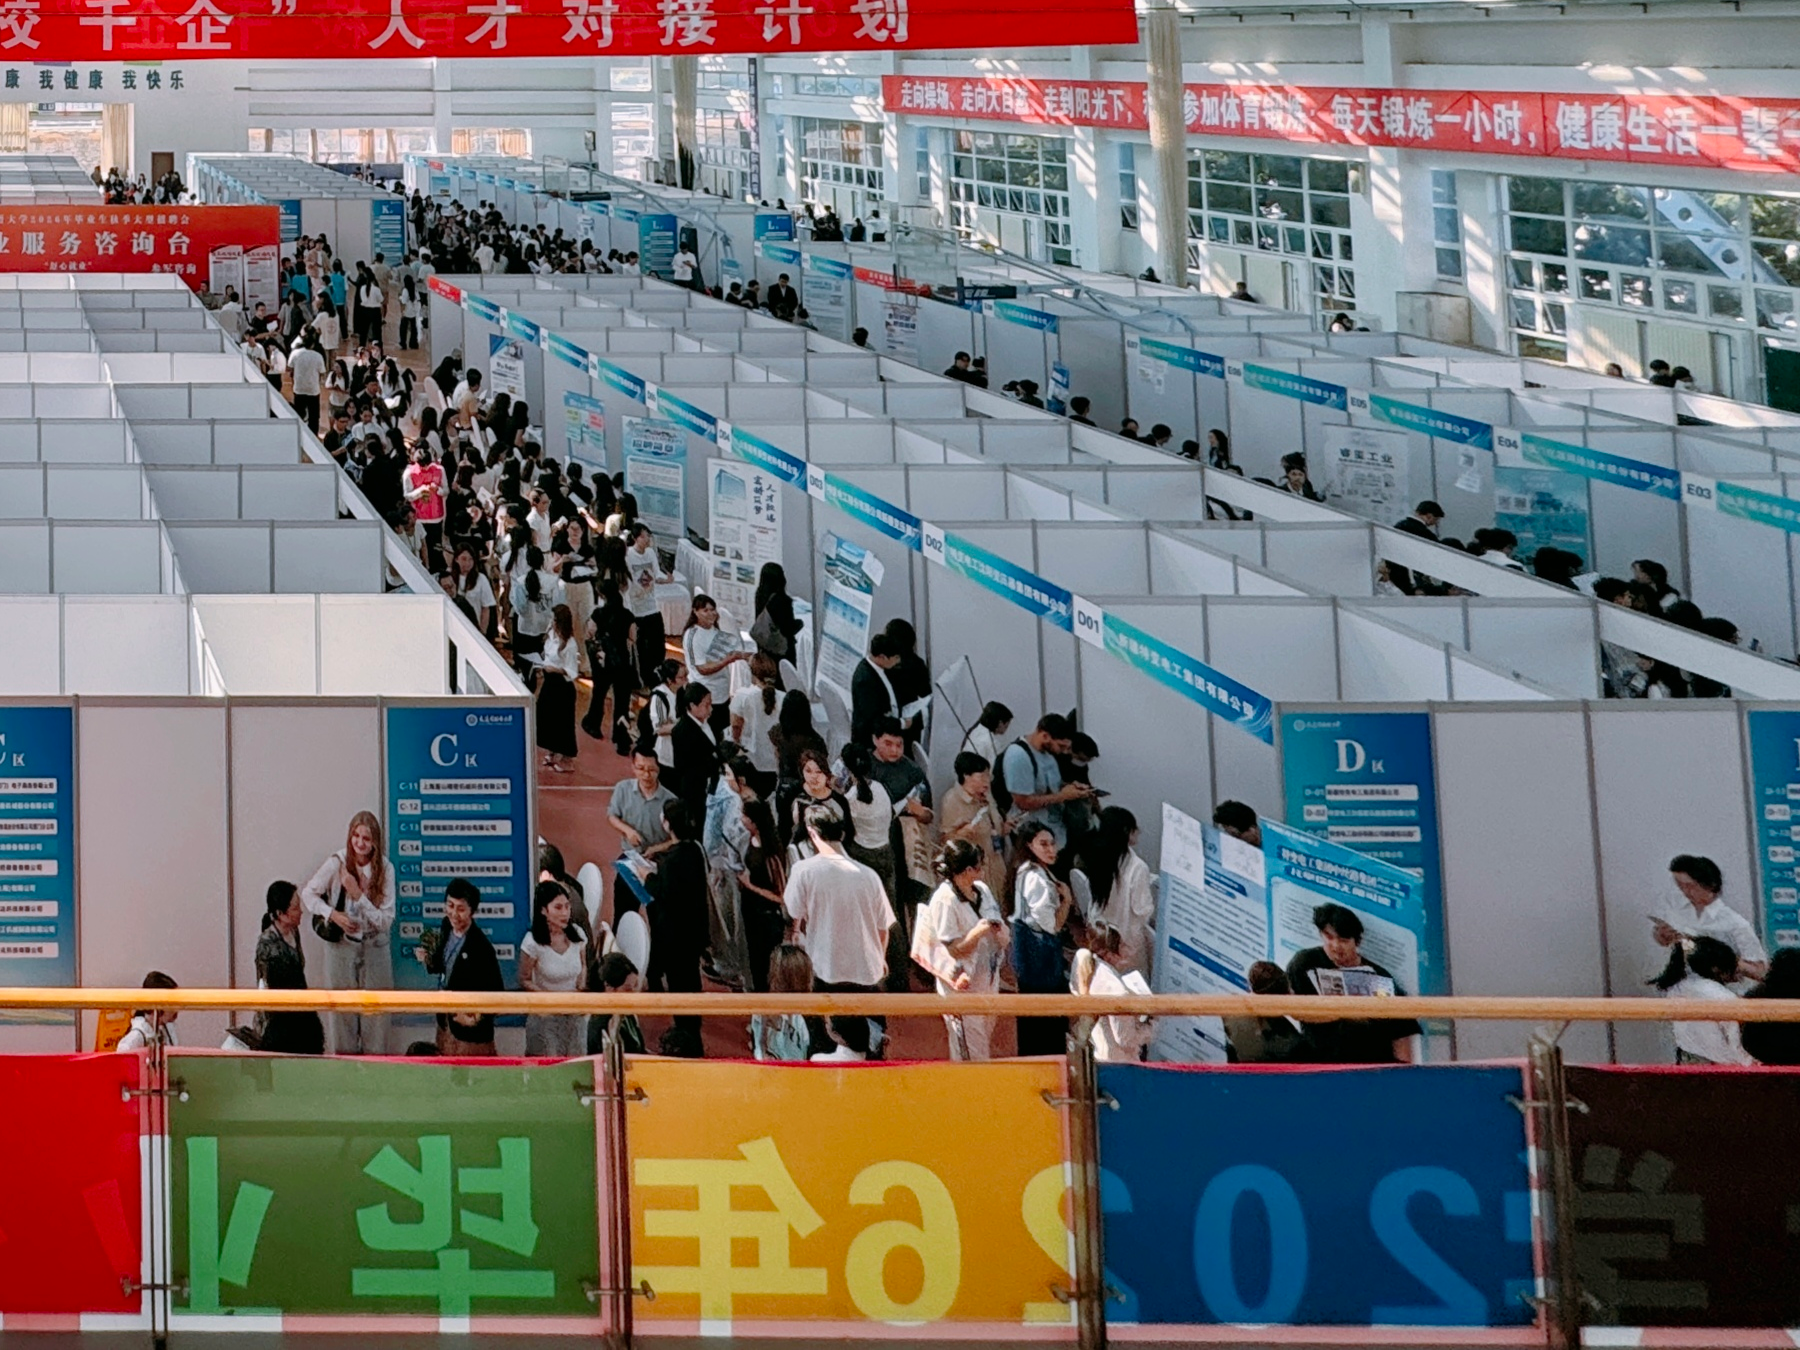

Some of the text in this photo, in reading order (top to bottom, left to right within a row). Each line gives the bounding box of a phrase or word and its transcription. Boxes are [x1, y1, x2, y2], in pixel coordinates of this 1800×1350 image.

[39, 68, 105, 90] 我健康
[122, 68, 185, 90] 我快乐
[1498, 436, 1518, 451] E04
[809, 472, 824, 490] D03
[1686, 483, 1712, 499] E03
[925, 534, 943, 552] D02
[1078, 609, 1100, 634] D01
